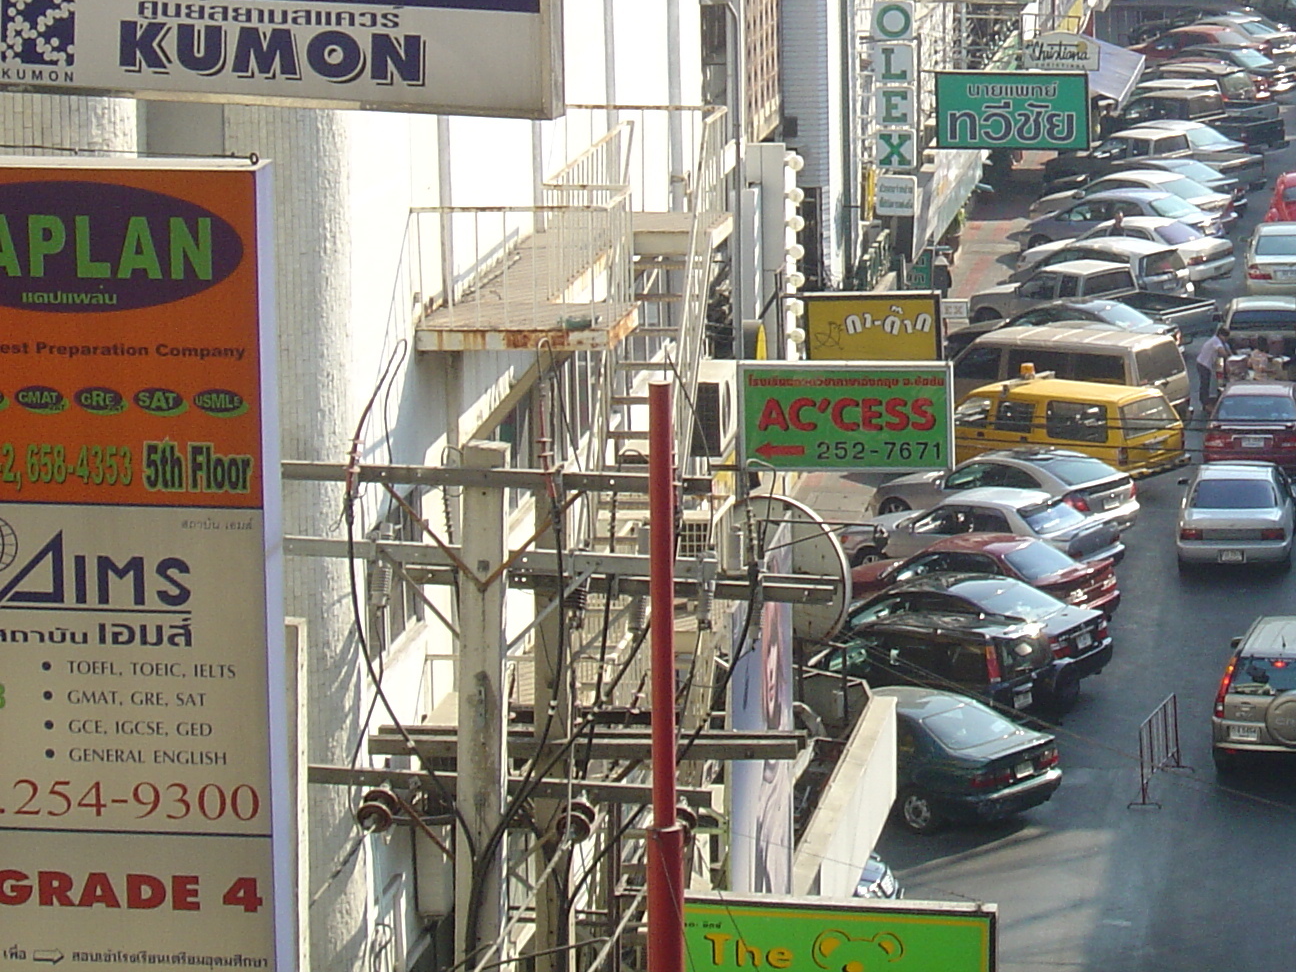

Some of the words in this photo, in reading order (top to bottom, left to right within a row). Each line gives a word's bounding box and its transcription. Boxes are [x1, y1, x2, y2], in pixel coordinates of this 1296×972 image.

[118, 19, 426, 87] KUMON
[1, 68, 75, 83] KUMON
[967, 81, 1059, 98] นายแพทย์
[947, 100, 1077, 145] ทวีชัย
[35, 341, 149, 358] Preparation
[155, 343, 246, 361] Company
[18, 390, 59, 404] GMAT
[80, 390, 115, 405] GRE
[138, 391, 178, 410] SAT
[194, 392, 241, 410] USMLE
[816, 441, 942, 461] 252-7671
[26, 443, 133, 487] 658-4353
[144, 440, 184, 492] 5th
[188, 442, 254, 494] Floor
[0, 529, 192, 607] AIMS
[194, 663, 237, 679] IELTS
[176, 692, 207, 707] SAT
[176, 722, 213, 737] GED
[68, 747, 146, 764] GENERAL
[153, 749, 228, 766] ENGLISH
[0, 869, 201, 912] GRADE
[222, 876, 263, 913] 4
[704, 932, 795, 969] The
